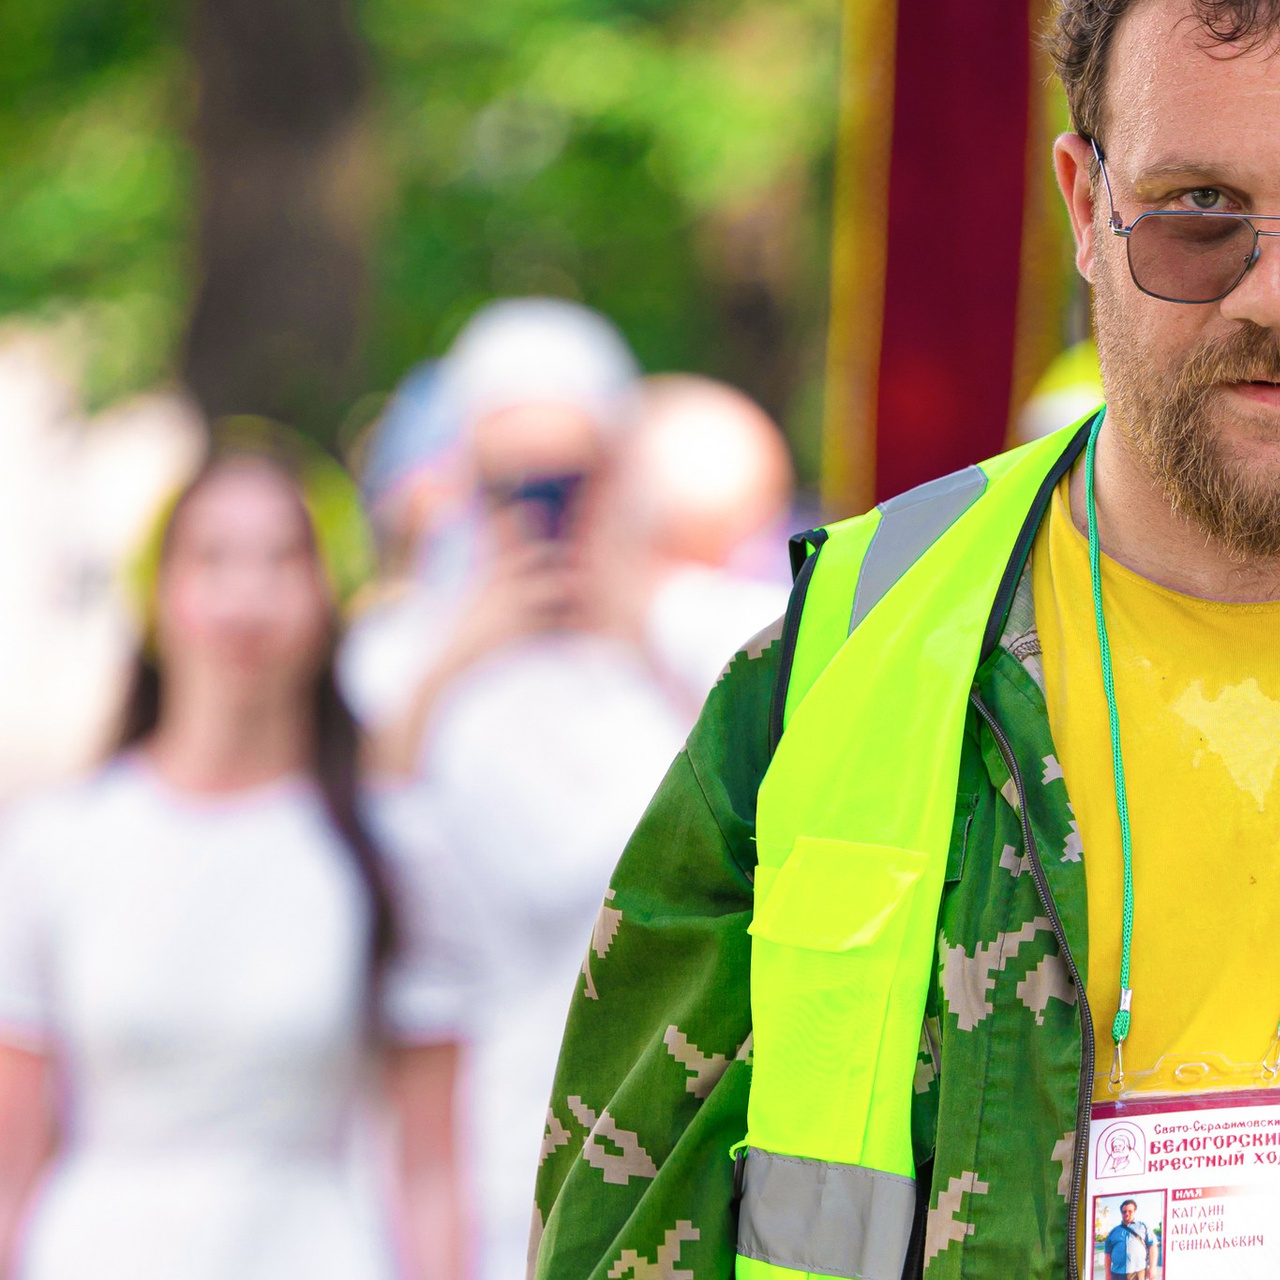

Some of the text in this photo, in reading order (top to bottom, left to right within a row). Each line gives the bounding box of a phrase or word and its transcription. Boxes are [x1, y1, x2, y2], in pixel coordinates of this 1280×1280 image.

[1148, 1150, 1245, 1173] КРЕСТНЫЙ
[1175, 1189, 1202, 1200] ИМЯ
[1171, 1218, 1224, 1236] АНДРЕЙ
[1171, 1234, 1265, 1252] ГЕННАДЬЕВИЧ
